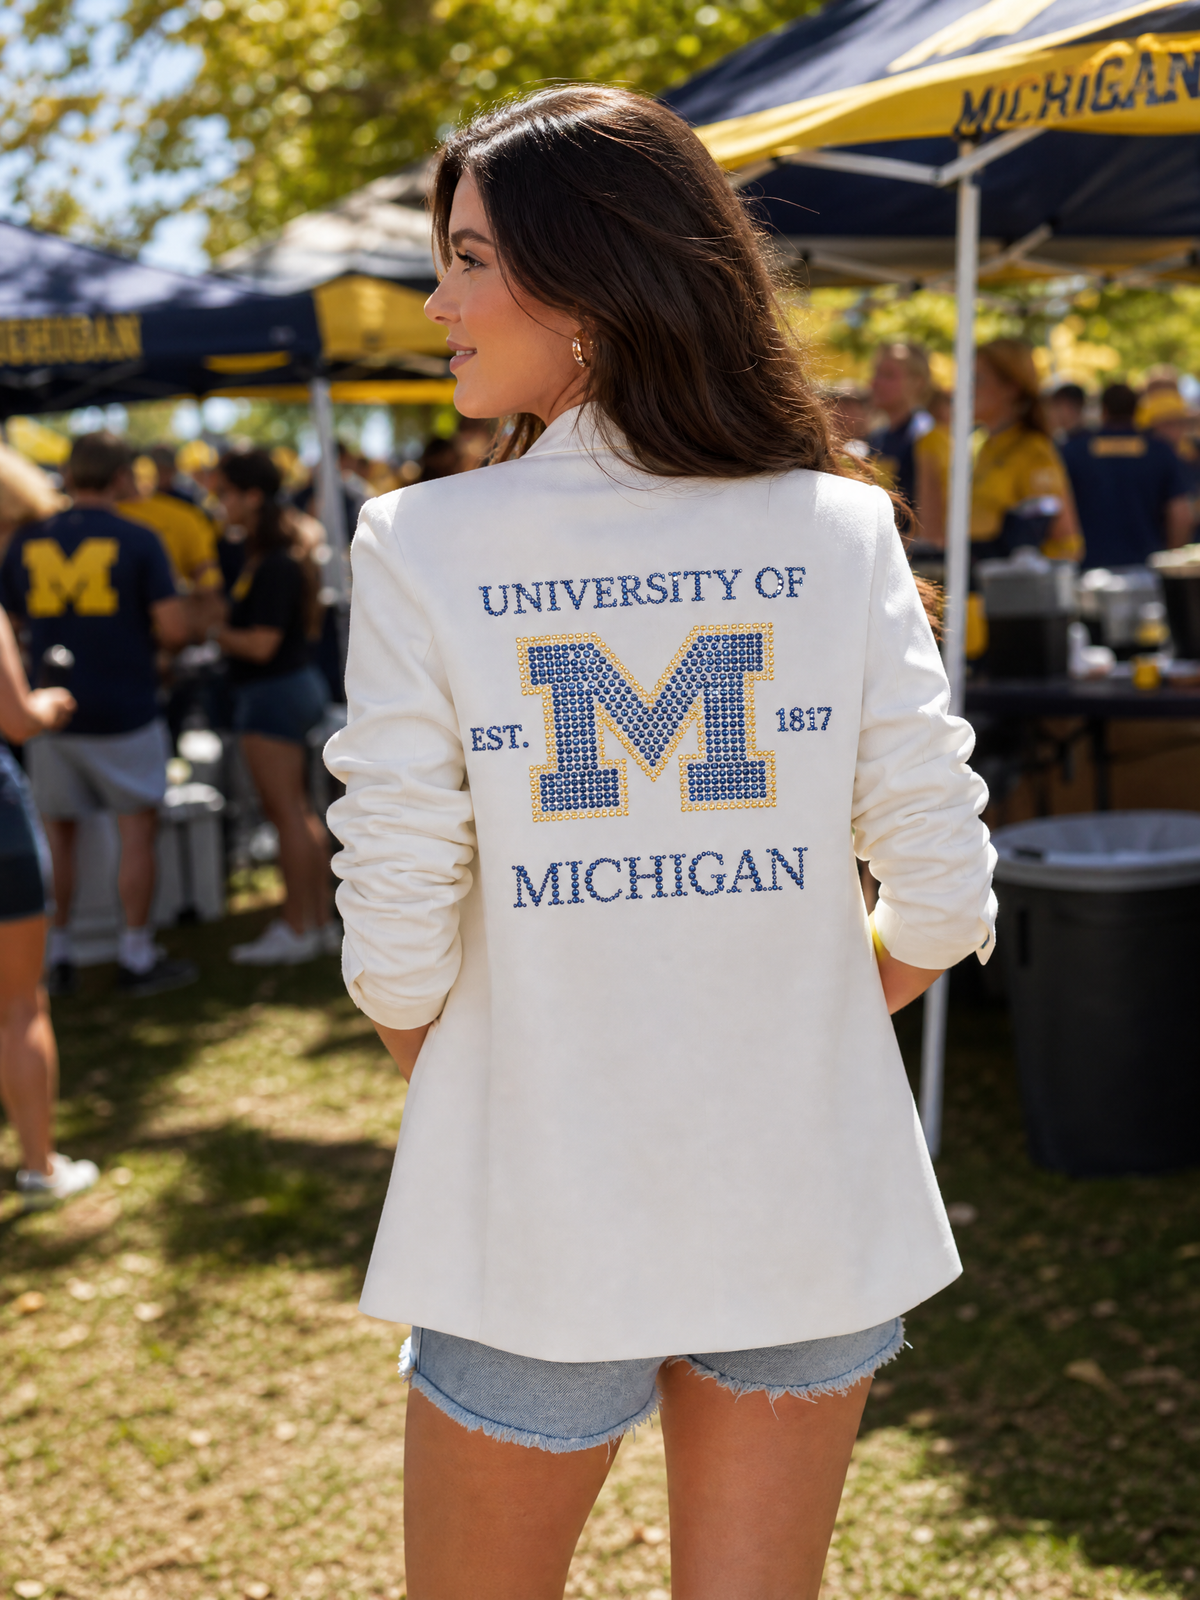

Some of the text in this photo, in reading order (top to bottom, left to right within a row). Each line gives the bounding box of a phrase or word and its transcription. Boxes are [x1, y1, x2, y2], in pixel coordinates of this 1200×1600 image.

[951, 50, 1200, 134] MICHIGAN
[22, 537, 120, 618] M
[478, 566, 806, 617] UNIVERSITY OF
[470, 724, 530, 751] EST.
[515, 621, 777, 823] M
[775, 706, 833, 732] 1817
[511, 846, 808, 908] MICHIGAN
